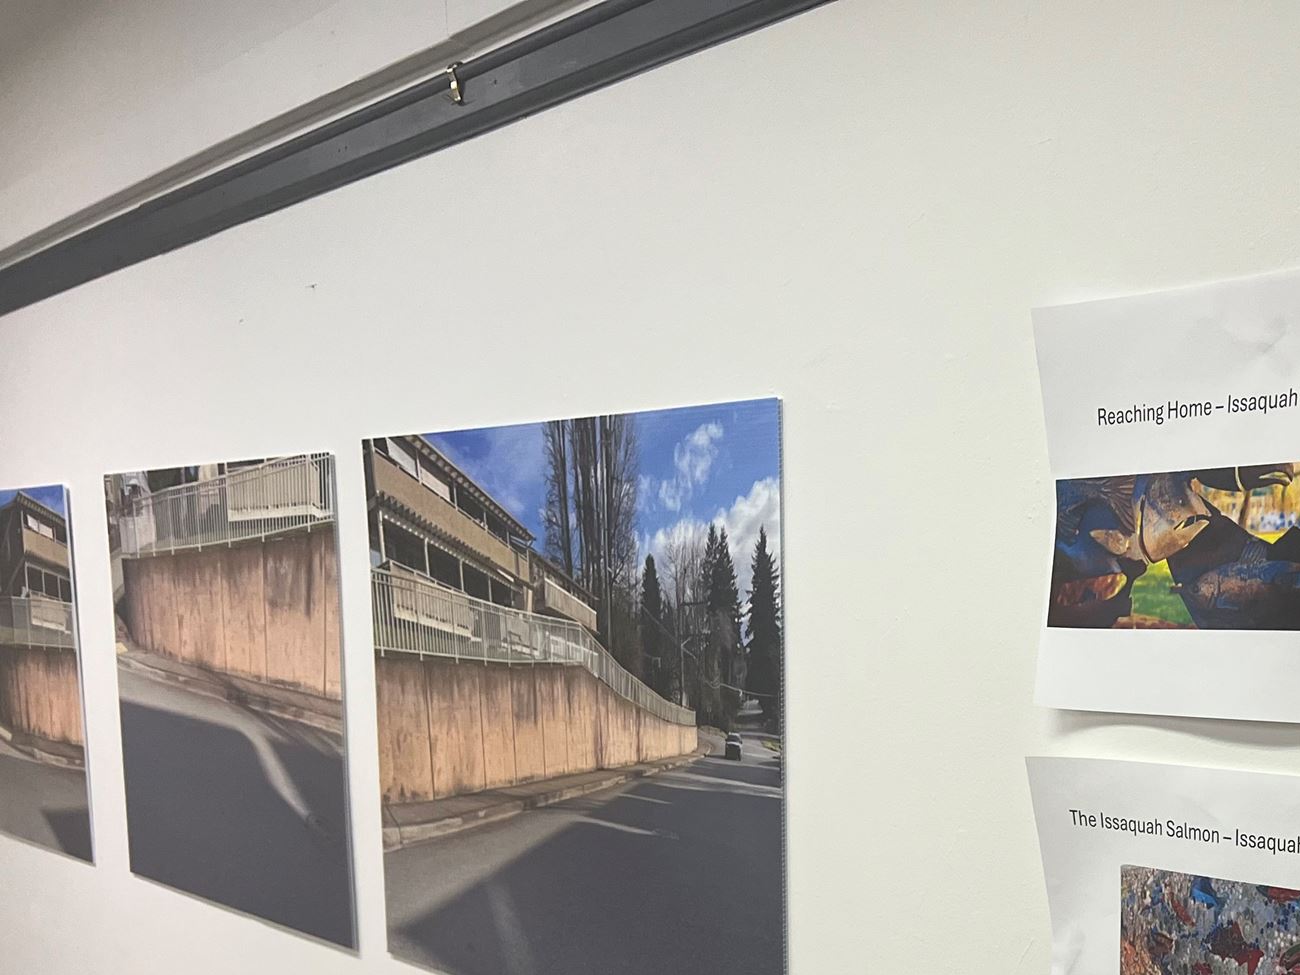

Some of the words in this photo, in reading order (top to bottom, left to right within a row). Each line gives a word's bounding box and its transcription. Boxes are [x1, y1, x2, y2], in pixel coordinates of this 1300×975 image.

[1097, 403, 1165, 427] Reaching
[1167, 399, 1213, 420] Home
[1227, 387, 1298, 415] Issaquah
[1068, 808, 1098, 829] The
[1099, 811, 1163, 837] Issaquah
[1165, 819, 1220, 845] Salmon
